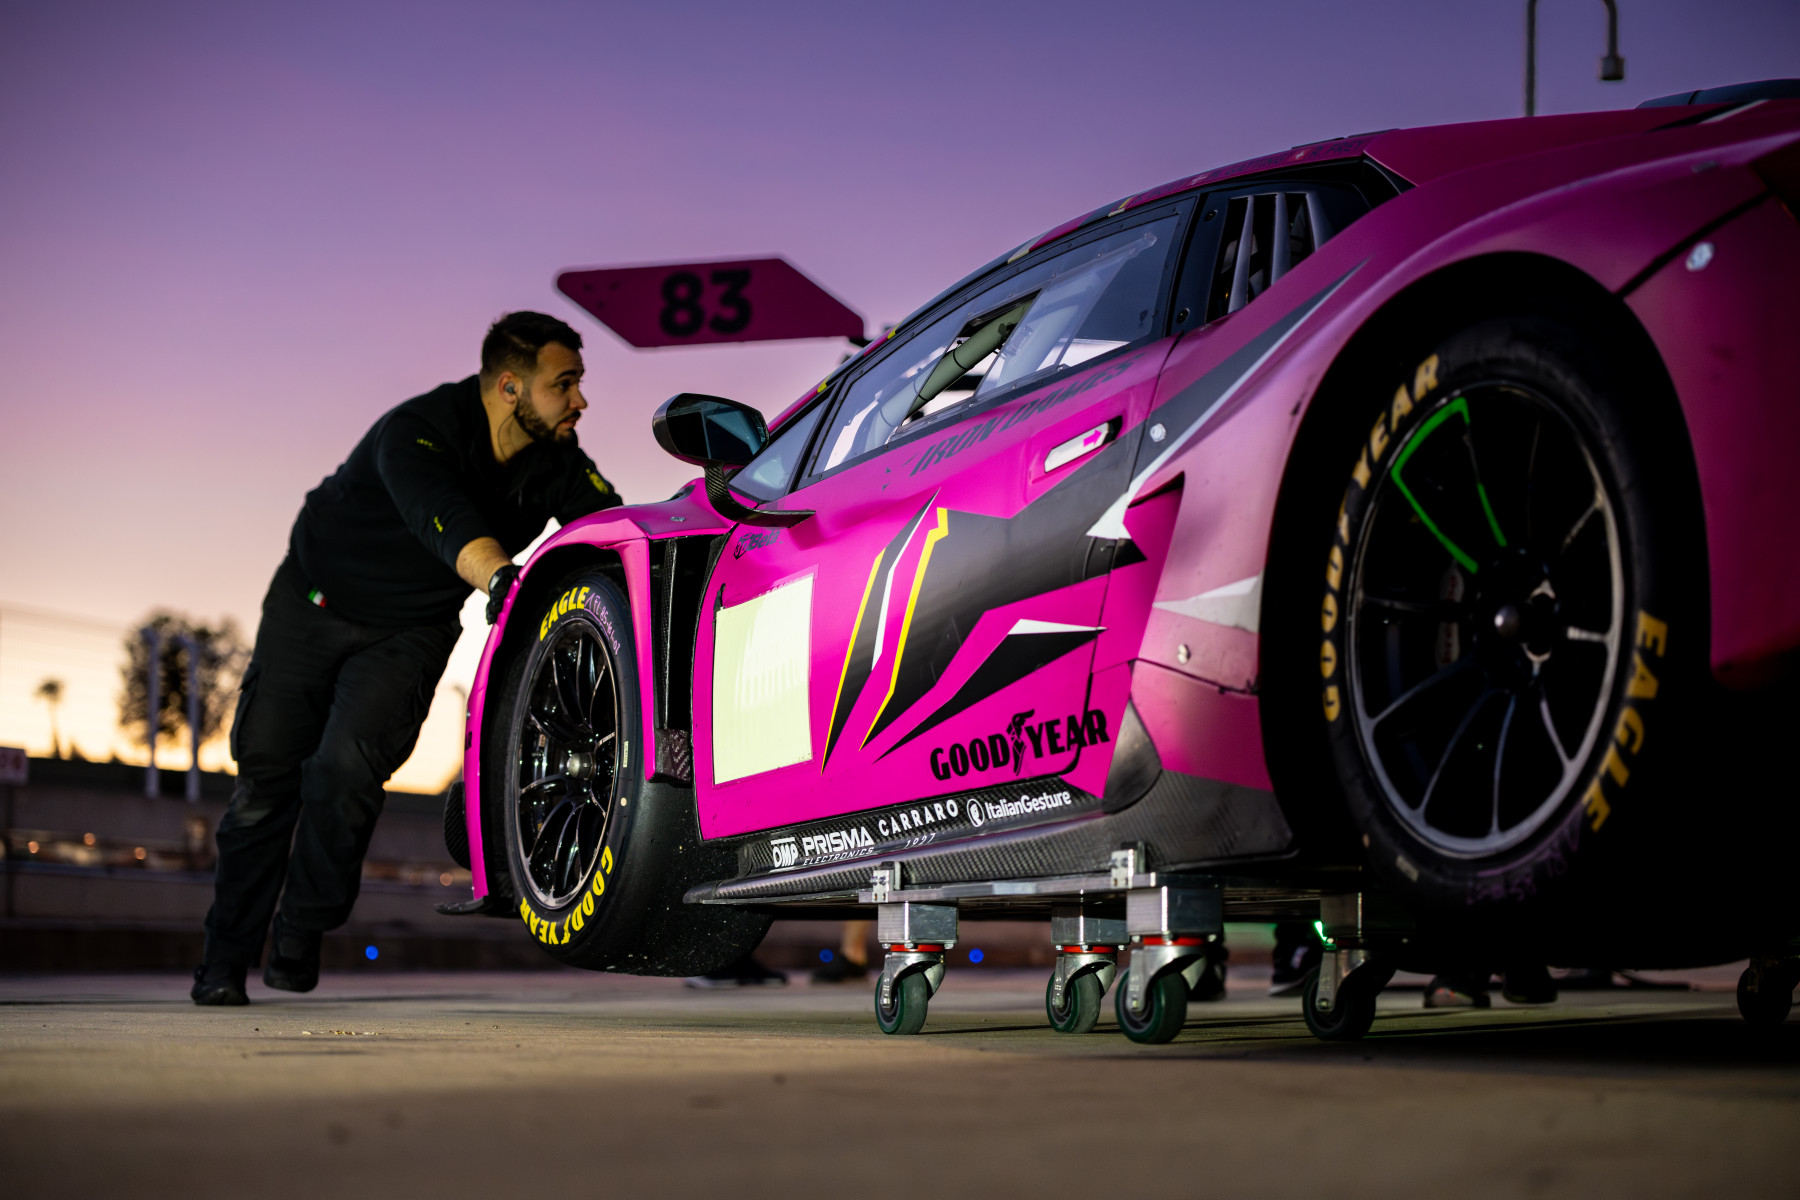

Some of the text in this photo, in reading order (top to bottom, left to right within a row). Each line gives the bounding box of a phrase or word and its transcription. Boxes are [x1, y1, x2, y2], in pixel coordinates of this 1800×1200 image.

[658, 267, 753, 338] 83
[540, 586, 590, 642] EAGLE
[1582, 608, 1669, 831] EAGLE
[930, 709, 1111, 781] GOODYEAR
[878, 799, 959, 837] CARRARO
[984, 791, 1072, 819] ItalianGesture
[771, 842, 799, 868] OMP
[802, 826, 874, 856] PRISMA
[802, 847, 875, 866] ELECTRONICS
